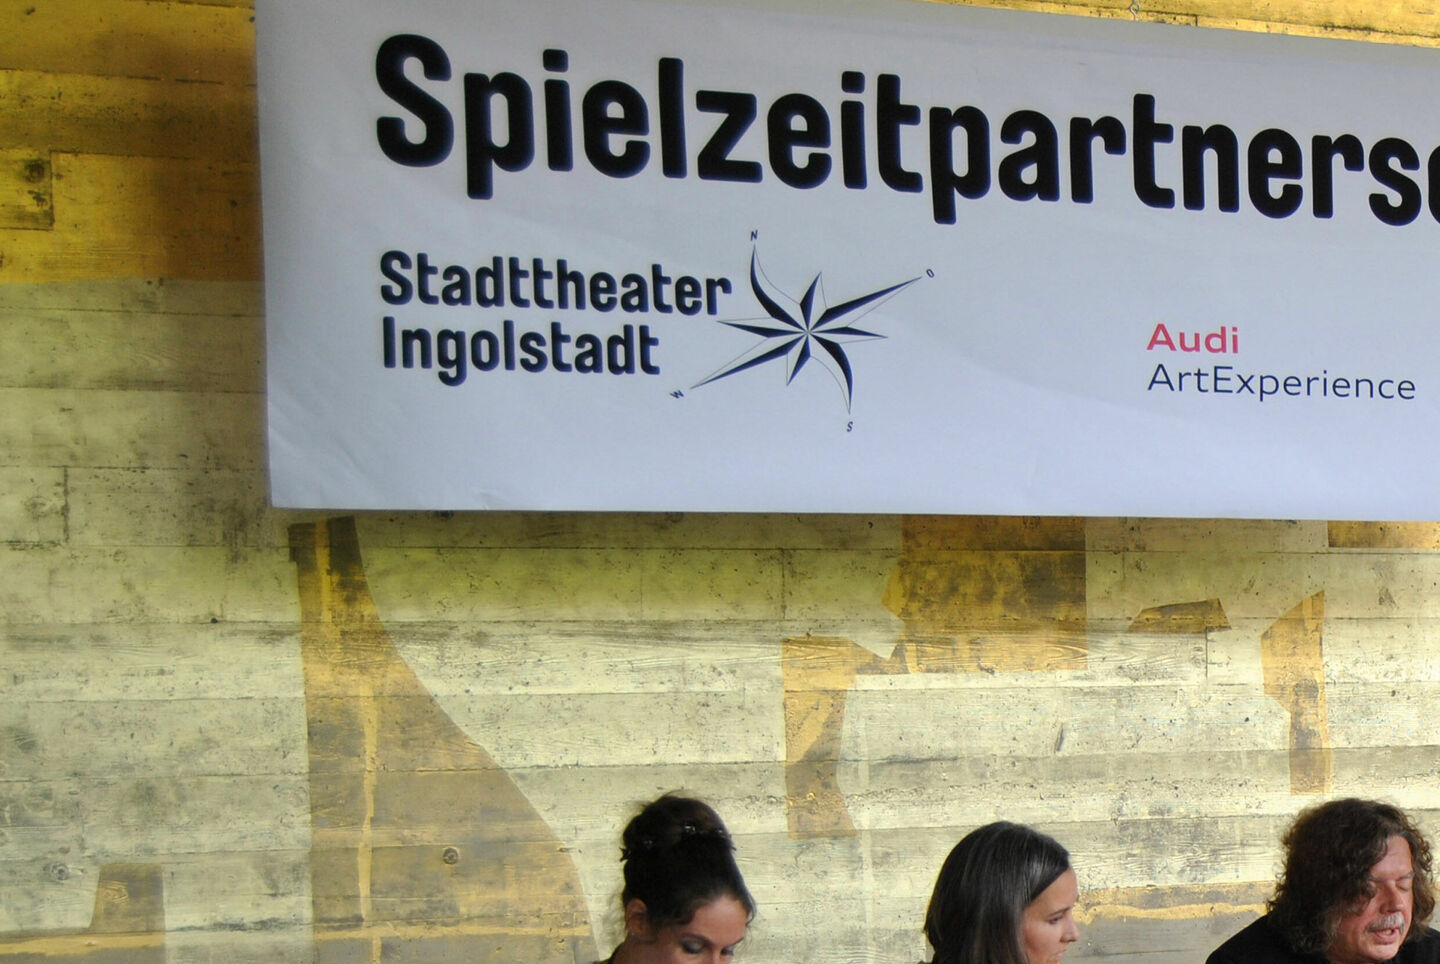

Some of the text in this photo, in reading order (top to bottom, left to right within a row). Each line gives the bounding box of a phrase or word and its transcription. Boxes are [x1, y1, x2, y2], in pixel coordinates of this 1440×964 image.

[381, 251, 733, 316] Stadttheater
[384, 316, 661, 387] Ingolstadt
[1148, 325, 1239, 354] Audi
[1149, 365, 1416, 402] ArtExperience
